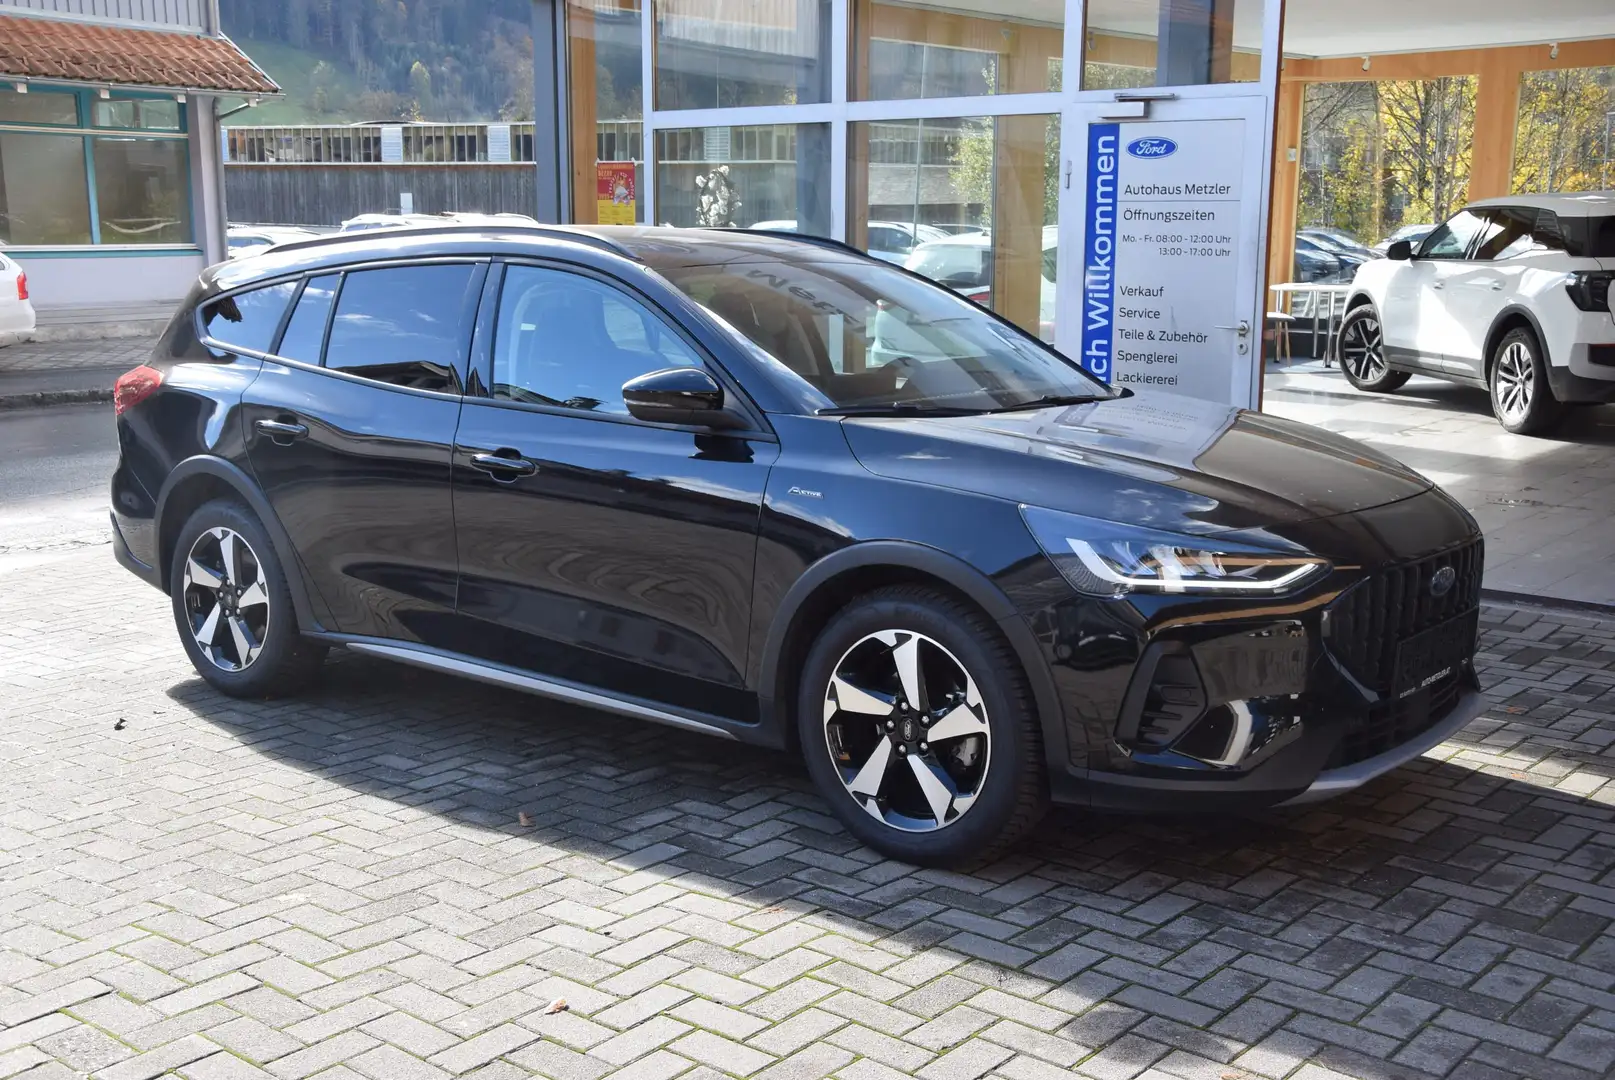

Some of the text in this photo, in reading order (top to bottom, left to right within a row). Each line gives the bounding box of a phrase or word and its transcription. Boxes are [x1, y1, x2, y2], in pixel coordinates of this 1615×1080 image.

[1136, 140, 1167, 155] Ford
[1124, 183, 1231, 195] Autohaus Metzler
[1123, 208, 1215, 223] Öffnungszeiten
[1088, 135, 1115, 331] Willkommen
[1122, 234, 1137, 243] Mo.
[1144, 234, 1154, 243] Fr.
[1155, 235, 1182, 243] 08:00
[1190, 235, 1213, 244] 12:00
[1215, 235, 1231, 244] Uhr
[1159, 247, 1182, 256] 13:00
[1190, 248, 1213, 256] 17:00
[1215, 248, 1231, 256] Uhr
[1119, 285, 1164, 297] Verkauf
[1119, 307, 1160, 319] Service
[1118, 328, 1208, 343] Teile & Zubehör
[1117, 350, 1178, 364] Spenglerei
[1116, 372, 1178, 385] Lackiererei
